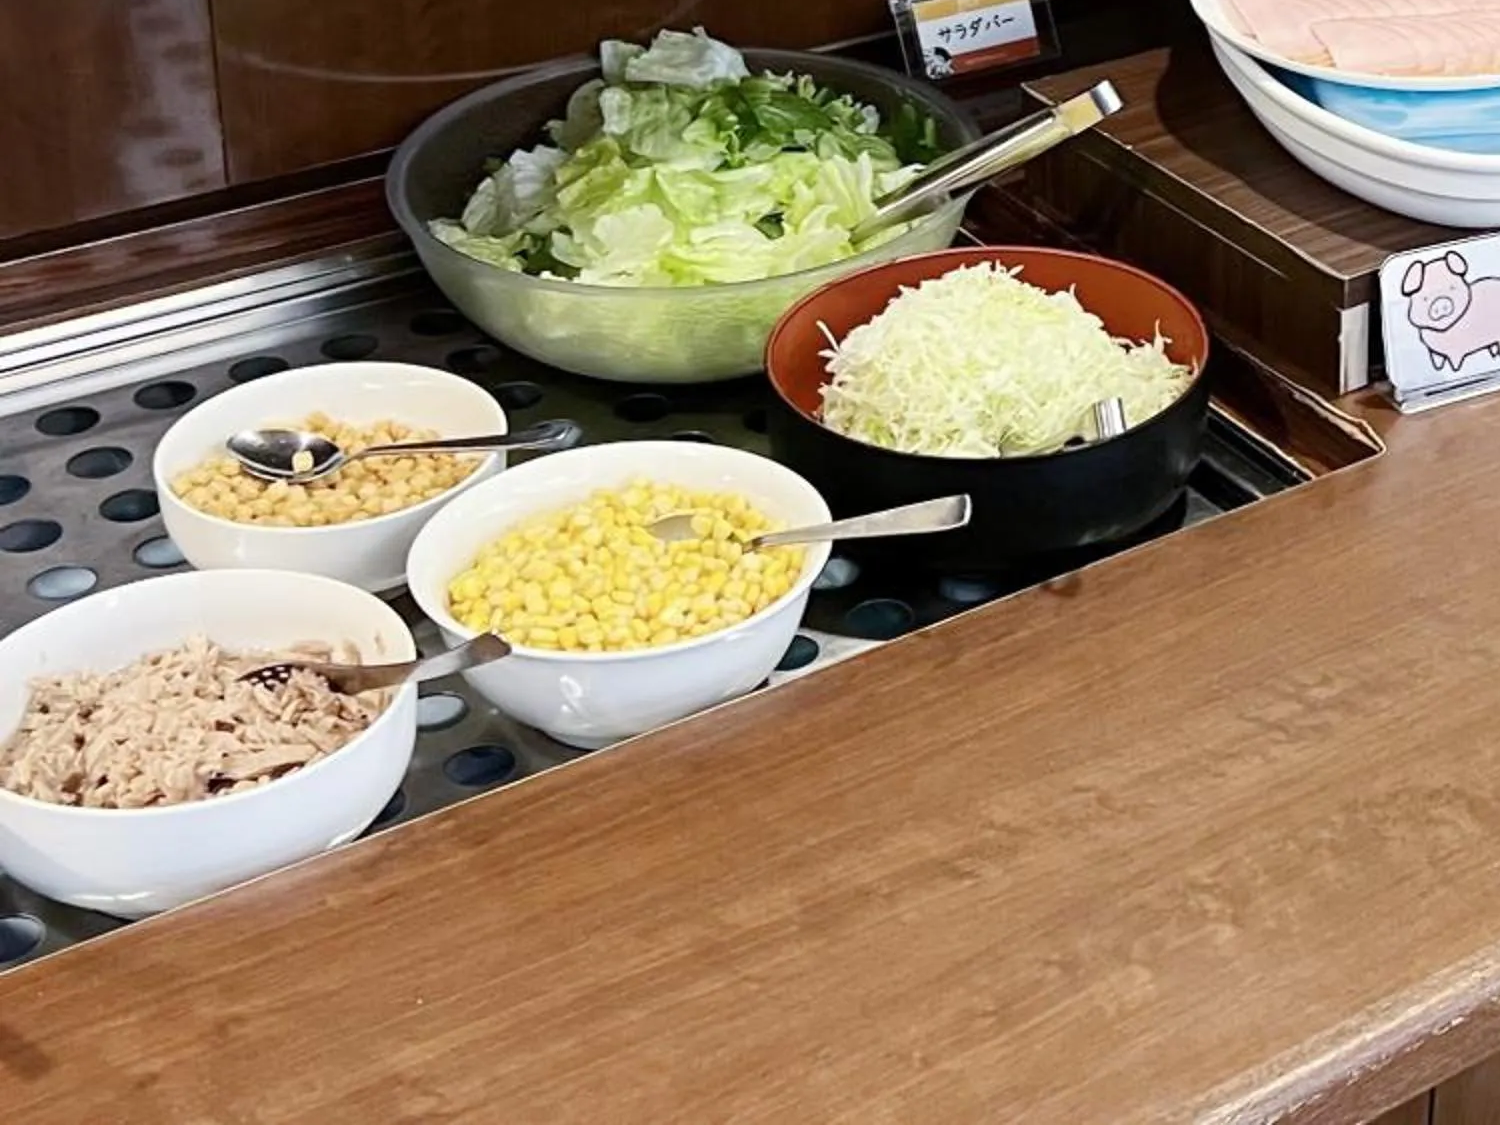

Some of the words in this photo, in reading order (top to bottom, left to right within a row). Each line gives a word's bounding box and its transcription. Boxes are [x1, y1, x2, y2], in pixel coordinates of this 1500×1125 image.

[937, 14, 1016, 43] サラダバー
